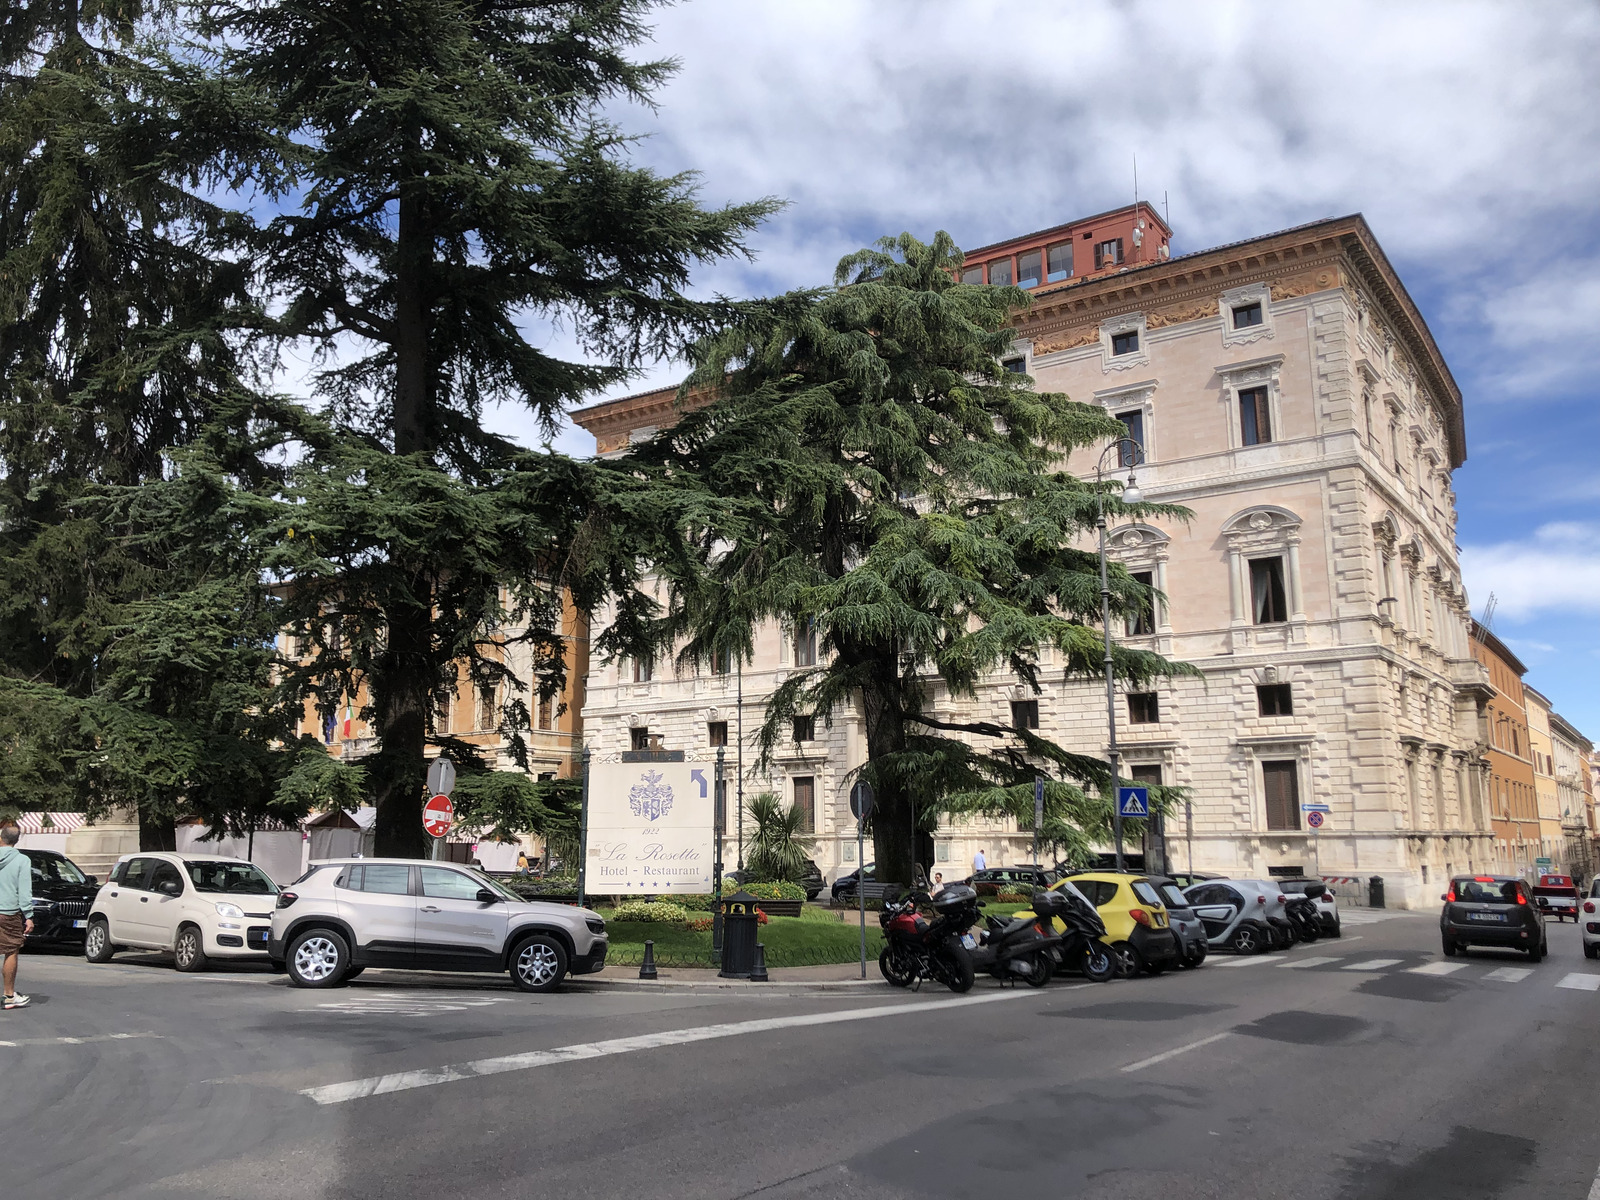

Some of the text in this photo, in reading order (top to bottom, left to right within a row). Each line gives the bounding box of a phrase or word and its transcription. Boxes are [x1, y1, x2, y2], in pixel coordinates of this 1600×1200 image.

[641, 828, 660, 836] 1922
[600, 866, 628, 876] Hotel
[643, 865, 700, 876] Restaurant
